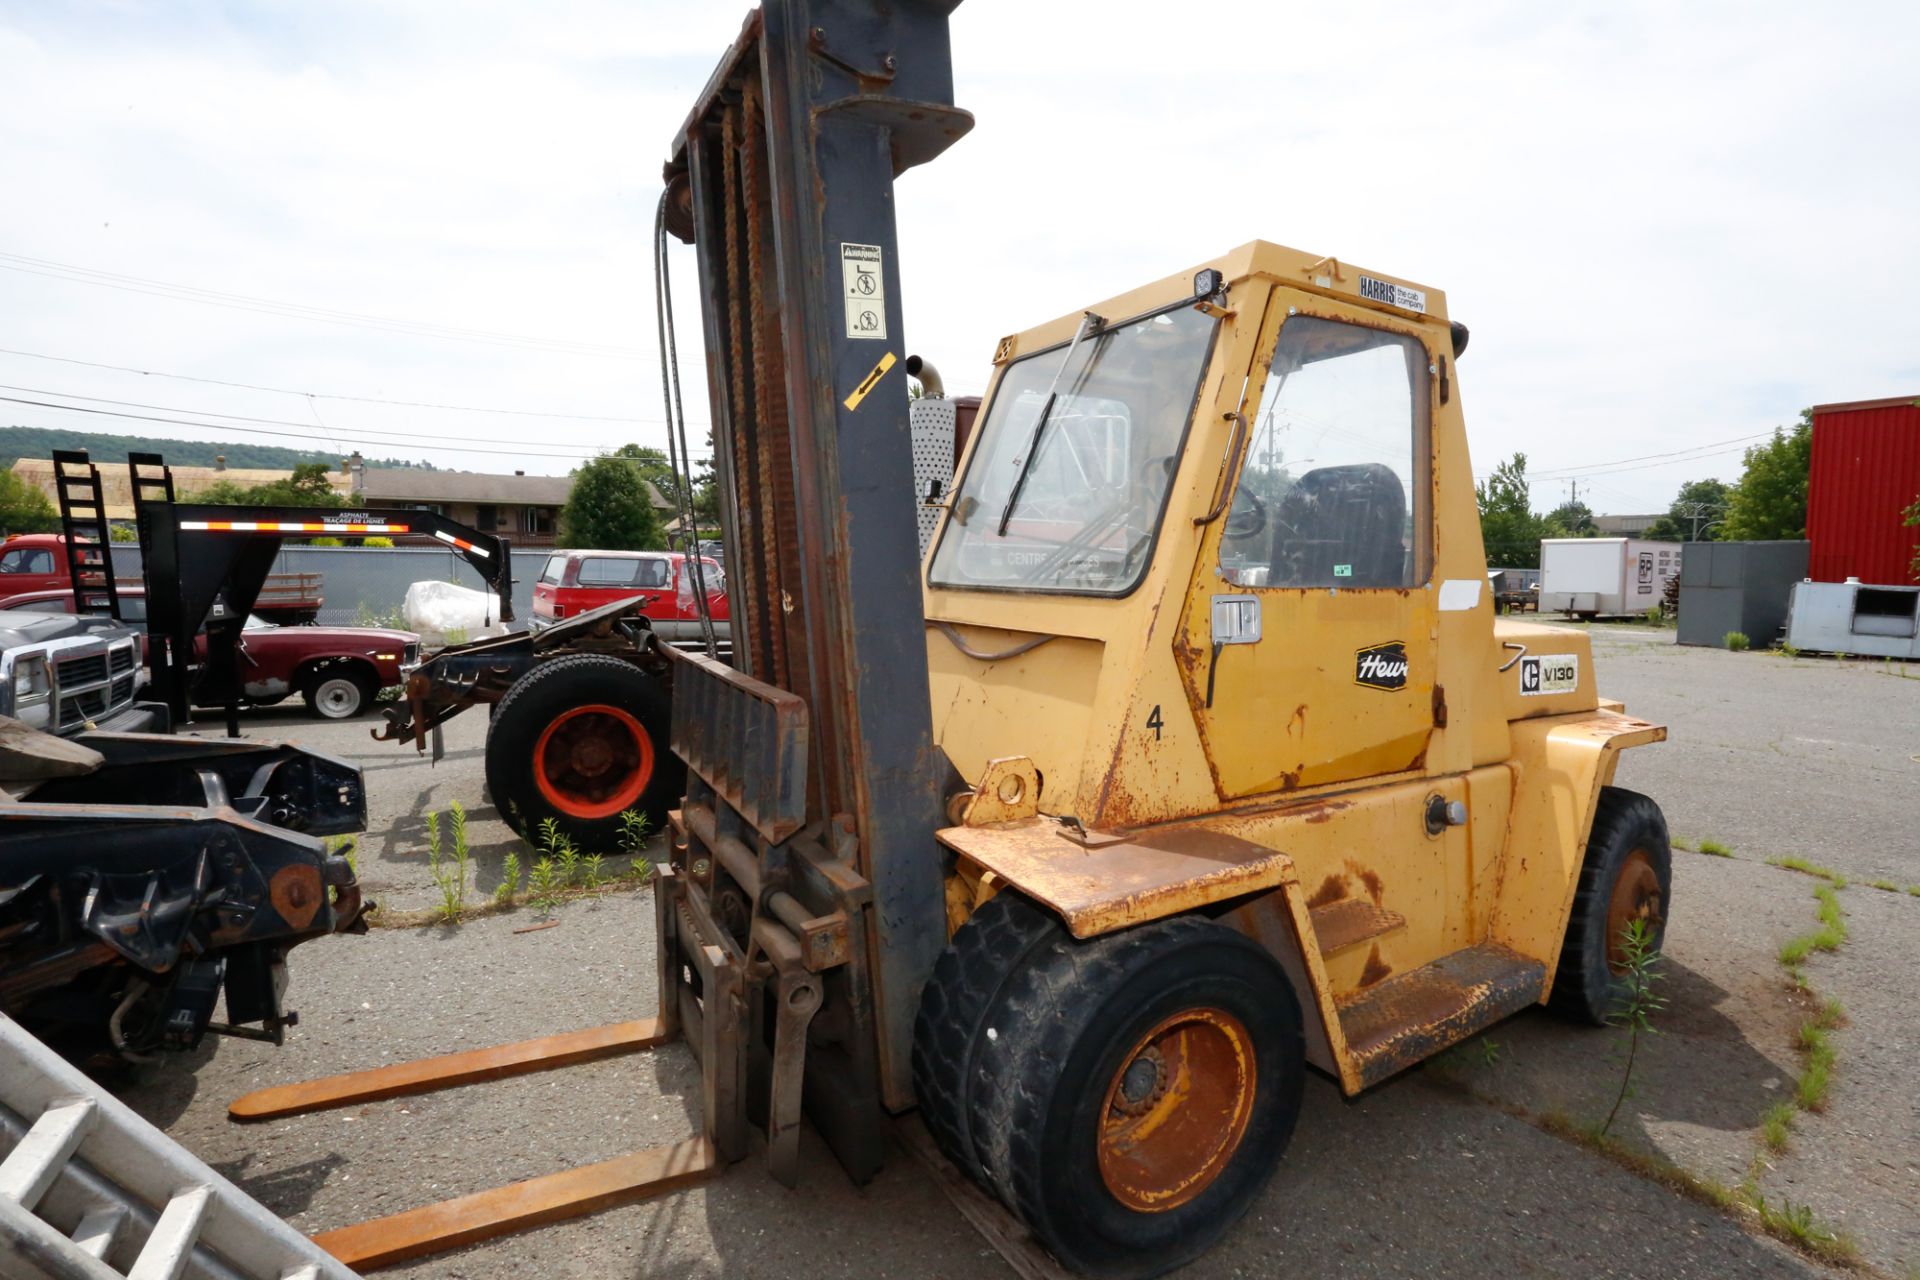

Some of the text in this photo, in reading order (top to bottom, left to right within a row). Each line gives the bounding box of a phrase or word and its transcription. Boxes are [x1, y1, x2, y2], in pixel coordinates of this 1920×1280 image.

[1360, 276, 1395, 304] HARRIS
[1397, 287, 1419, 301] the cab
[1397, 297, 1424, 311] company
[1544, 667, 1574, 681] V130
[1146, 704, 1164, 741] 4
